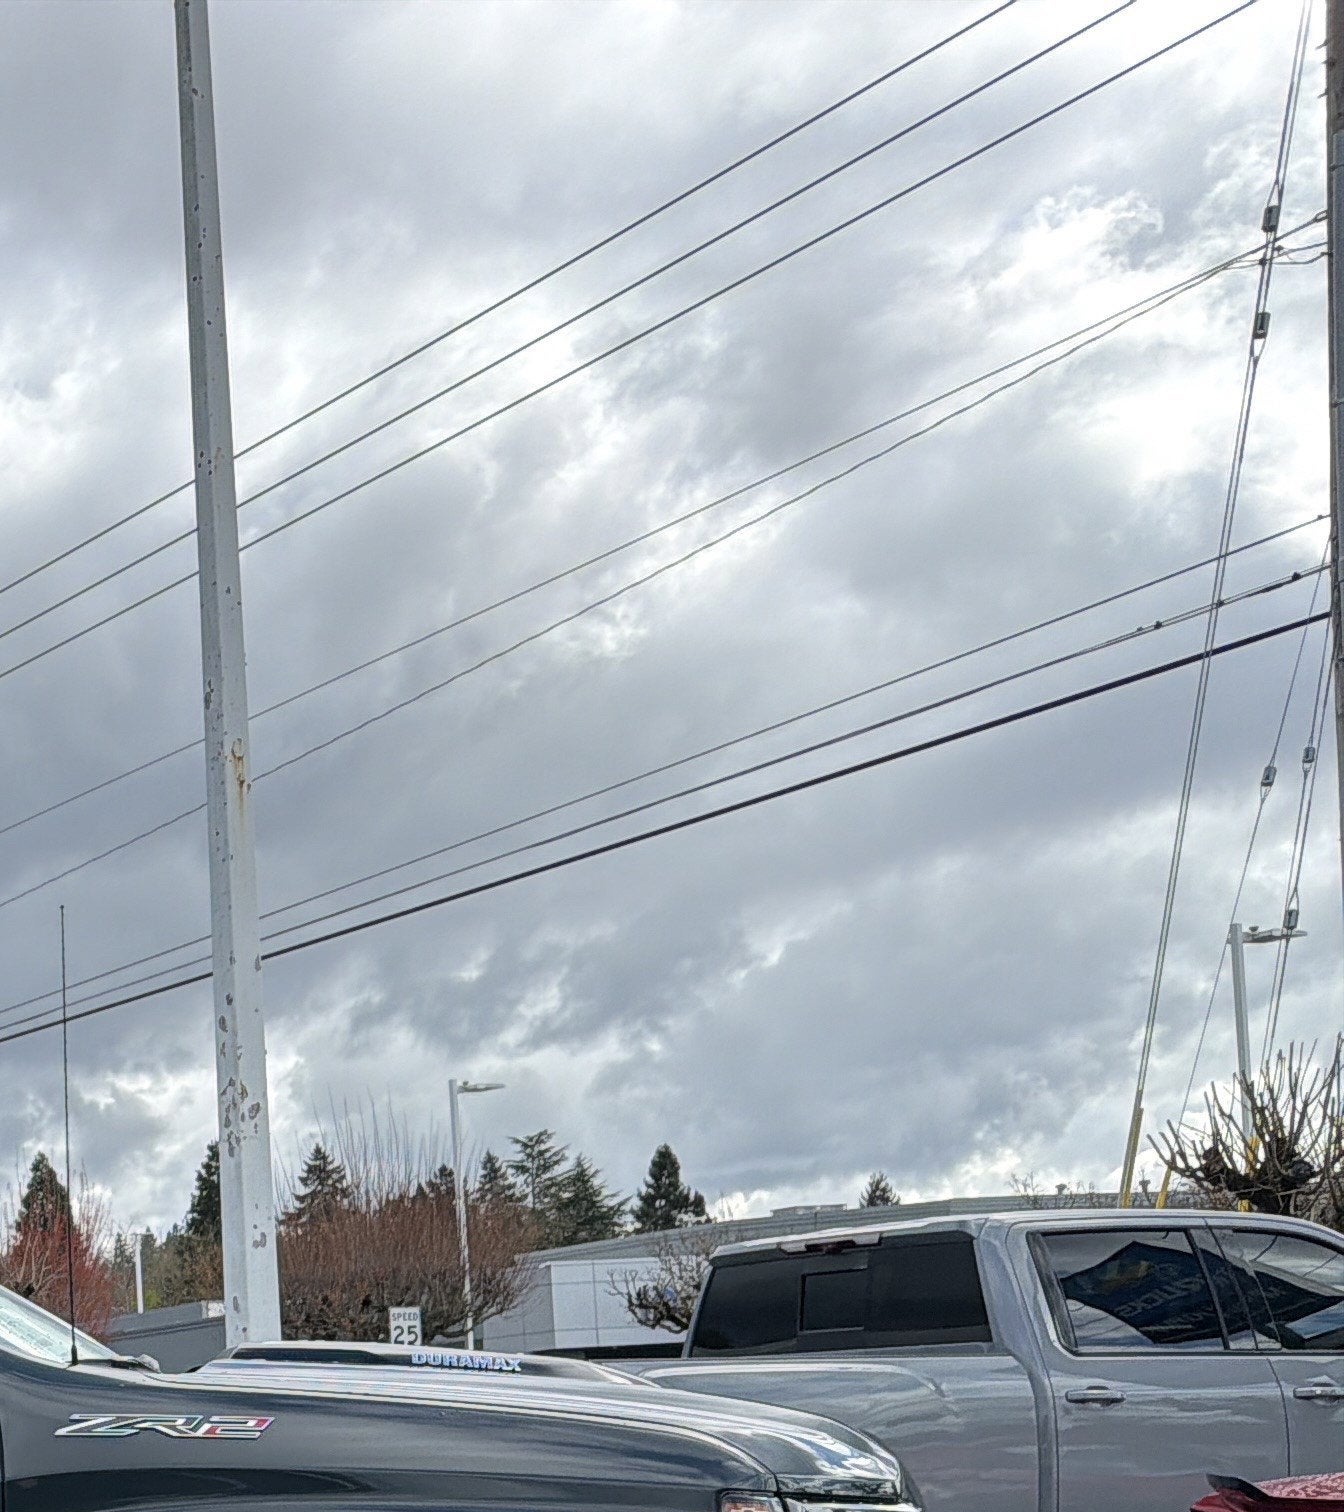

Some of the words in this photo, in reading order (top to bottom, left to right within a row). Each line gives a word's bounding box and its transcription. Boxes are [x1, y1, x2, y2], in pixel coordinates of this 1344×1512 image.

[392, 1312, 419, 1321] SPEED
[393, 1325, 419, 1345] 25
[411, 1352, 522, 1371] DURAMAX
[54, 1413, 276, 1440] ZR2
